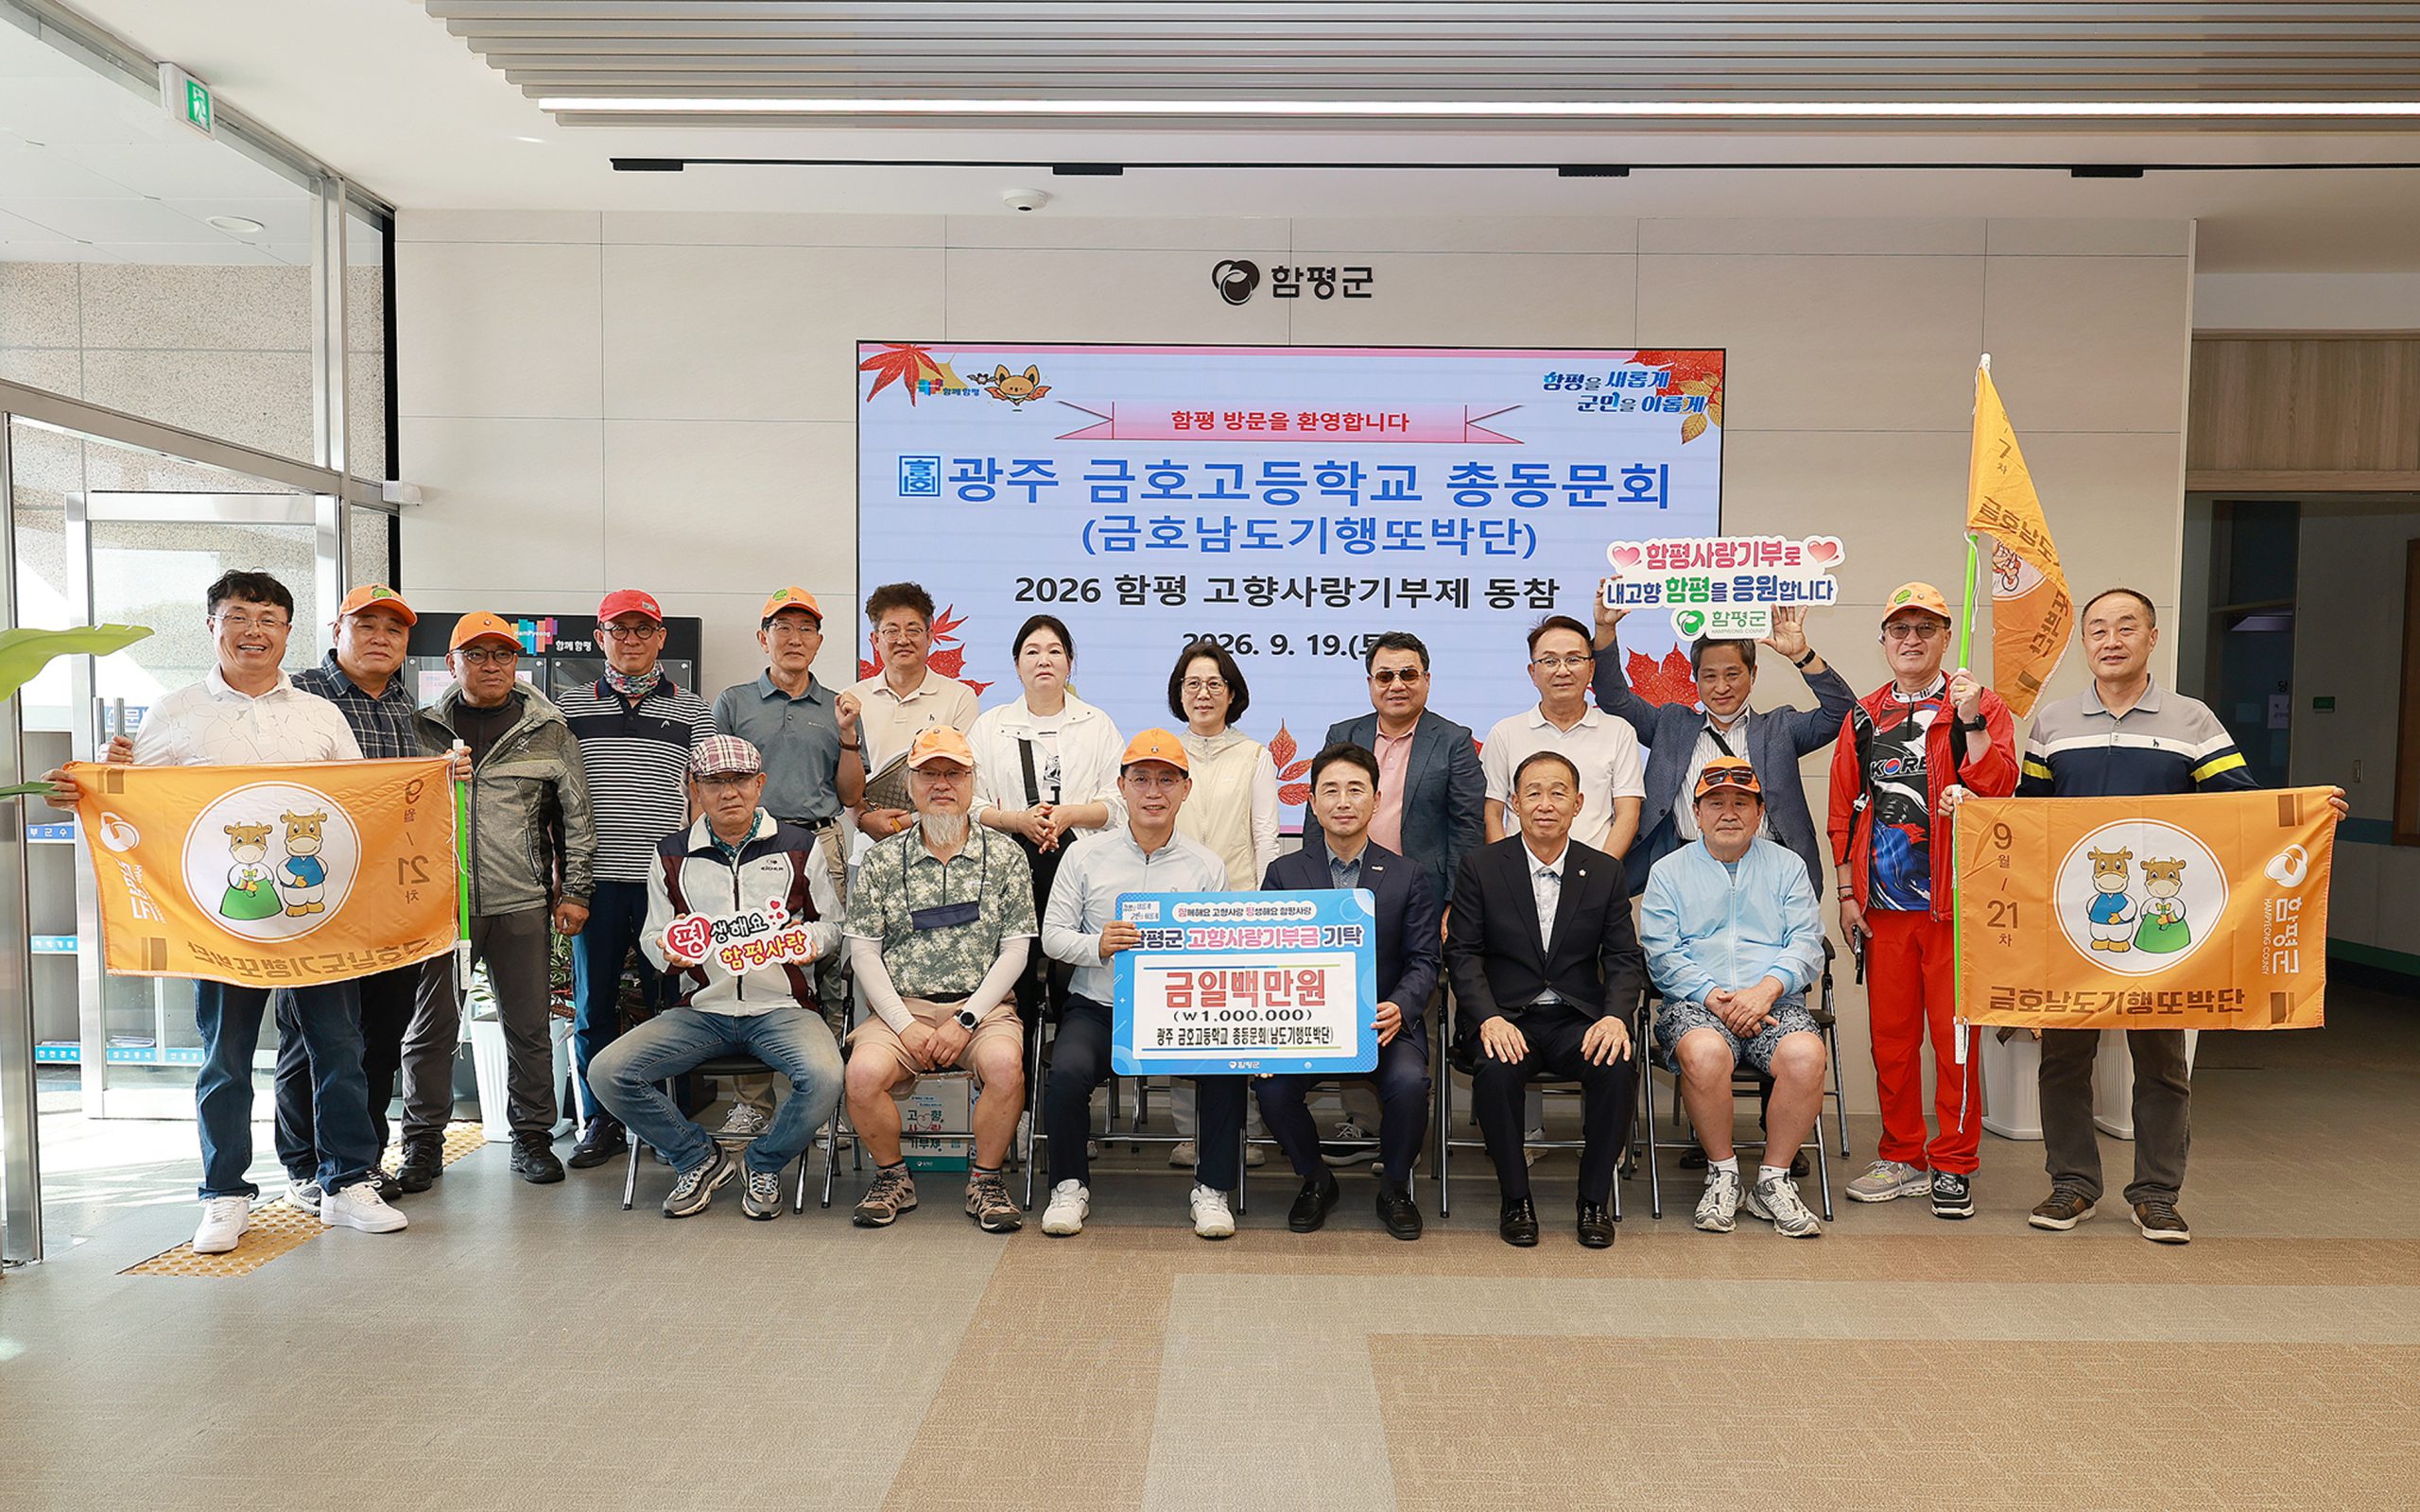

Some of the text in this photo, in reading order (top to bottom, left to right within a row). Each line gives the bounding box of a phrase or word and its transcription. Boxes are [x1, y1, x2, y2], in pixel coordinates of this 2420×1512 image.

[1270, 266, 1374, 299] 함평군
[1543, 370, 1670, 391] 함평을 새롭게
[1578, 392, 1705, 413] 군민을 이롭게
[1171, 410, 1409, 433] 함평 방문을 환영합니다
[948, 457, 1059, 503] 광주
[1083, 458, 1423, 507] 금호고등학교
[1446, 460, 1669, 509] 총동문회
[1081, 515, 1537, 559] (금호남도기행또박단)
[1646, 541, 1801, 570] 함평사랑기부로
[1014, 575, 1560, 609] 2026 함평 고향사랑기부제 동참
[1607, 575, 1834, 604] 내고향 함평을 응원합니다
[1712, 610, 1766, 627] 함평군
[1270, 634, 1295, 655] 9.
[1993, 822, 2013, 850] 9
[1986, 900, 2018, 929] 21
[1188, 927, 1319, 948] 고향사랑기부금
[1322, 927, 1363, 946] 기탁
[1997, 933, 2013, 947] 차
[2273, 896, 2303, 974] 함평군
[719, 929, 806, 971] 함평사랑
[1165, 969, 1326, 1008] 금일백만원
[1989, 986, 2245, 1015] 금호남도기행또박단
[1157, 1026, 1334, 1046] 광주 금호고등학교 총동문회(남도기행또박단)
